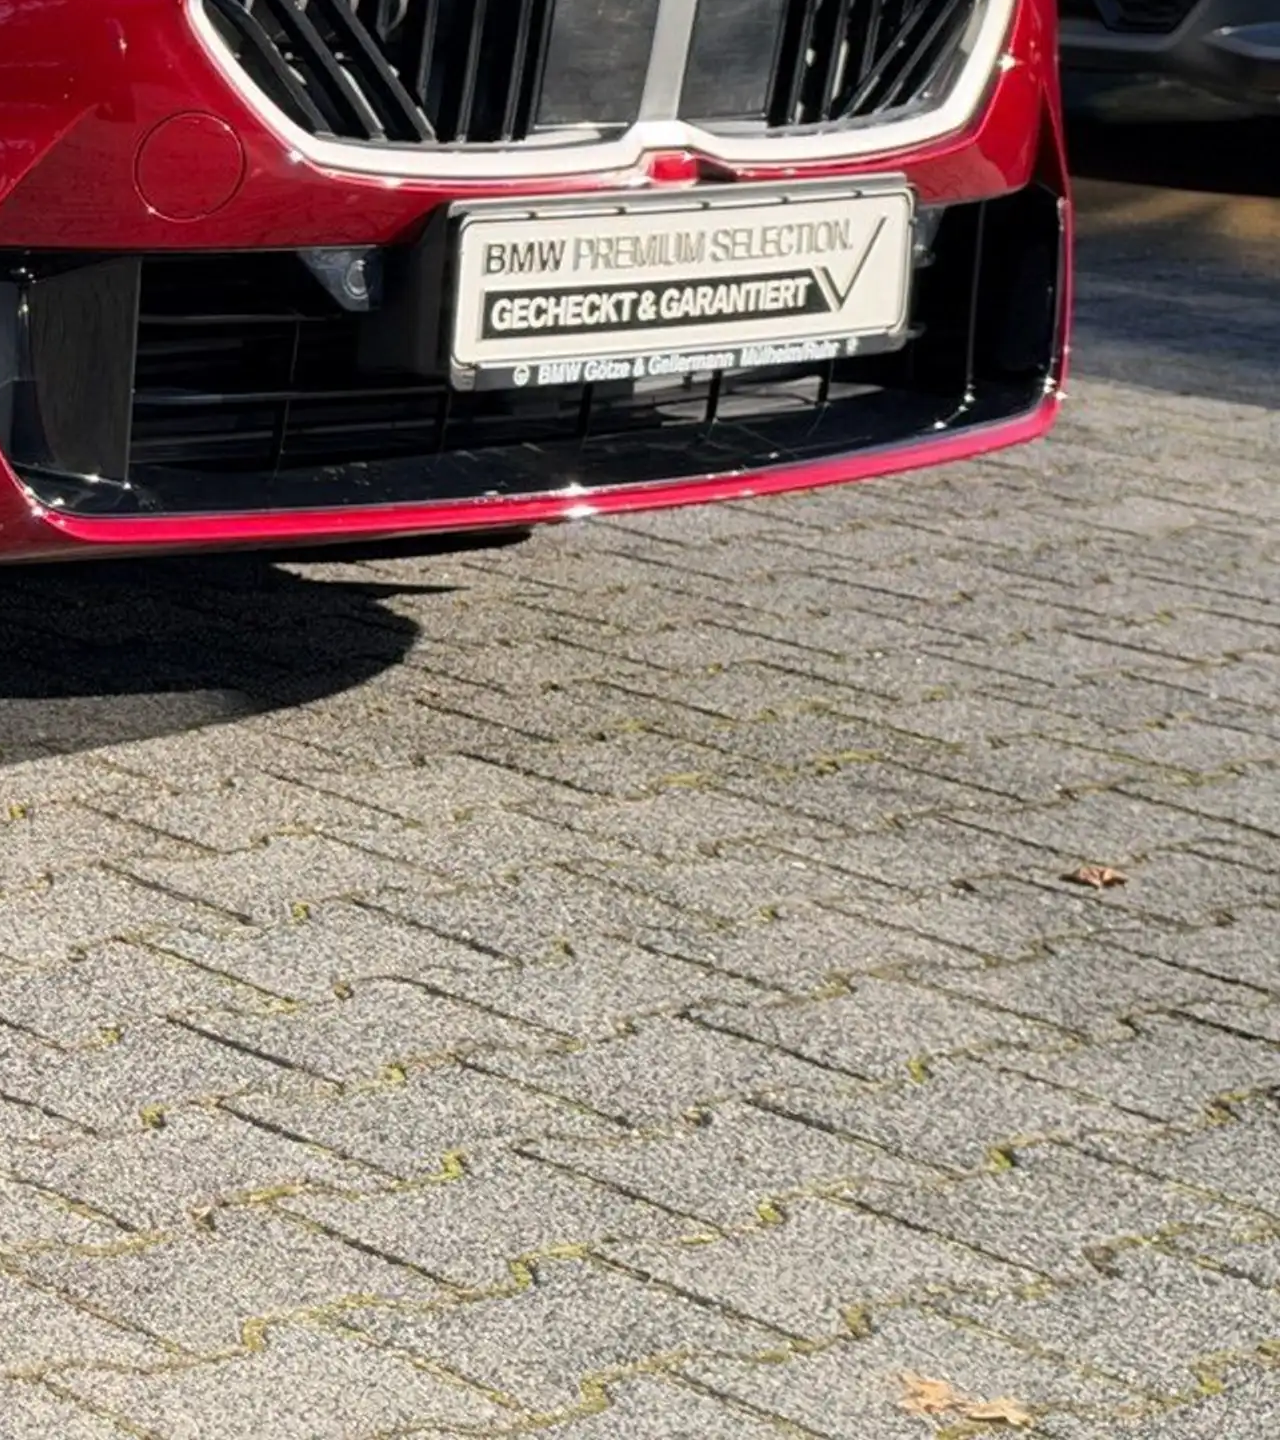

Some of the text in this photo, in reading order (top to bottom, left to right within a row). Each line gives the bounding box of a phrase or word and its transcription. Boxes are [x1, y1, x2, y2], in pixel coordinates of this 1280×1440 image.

[484, 240, 565, 276] BMW
[573, 231, 708, 271] PREMIUM
[490, 277, 812, 332] GECHECKT & GARANTIERT
[538, 361, 583, 386] BMW
